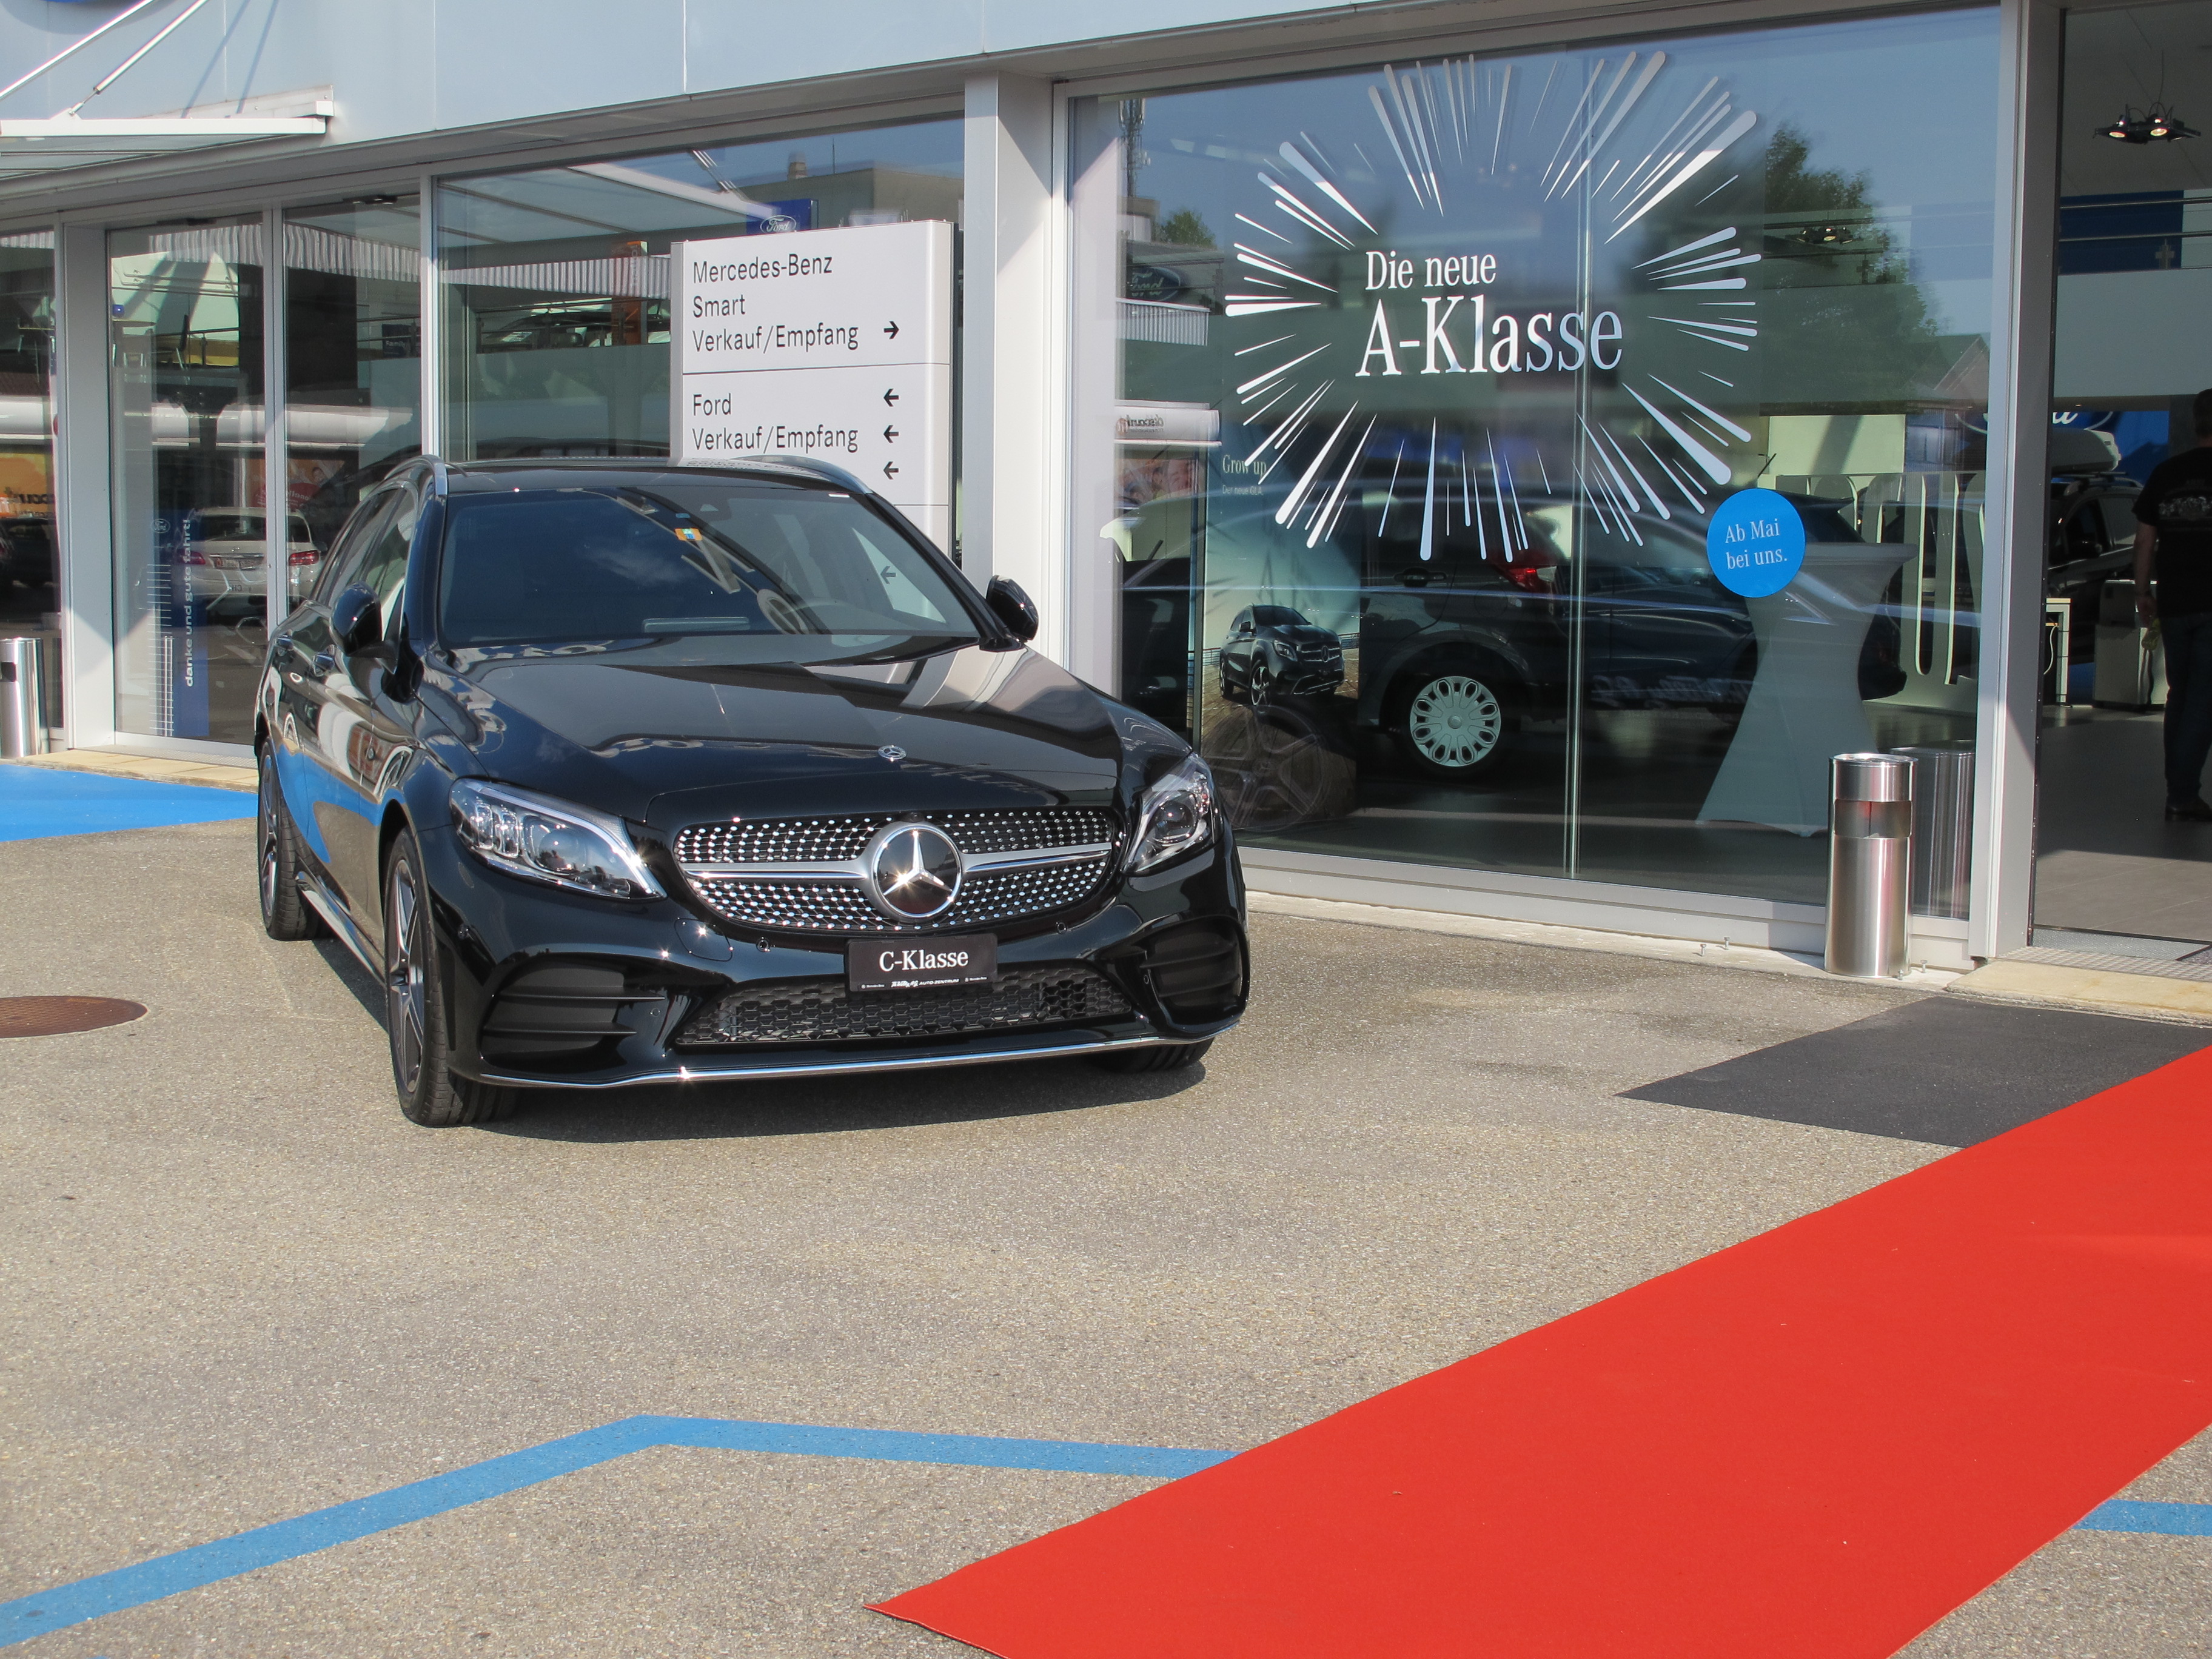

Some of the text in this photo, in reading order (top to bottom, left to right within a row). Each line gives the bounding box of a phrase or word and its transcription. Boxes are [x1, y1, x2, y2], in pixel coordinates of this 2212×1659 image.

[692, 253, 833, 284] Mercedes-Benz
[1365, 250, 1496, 290] Die neue
[692, 294, 746, 318] Smart
[692, 322, 860, 354] Verkauf/Empfang
[1355, 294, 1623, 377] A-Klasse
[692, 392, 732, 417] Ford
[692, 424, 859, 454] Verkauf/Empfang
[1222, 454, 1267, 480] Grow up
[1724, 518, 1780, 544] Ab Mai
[1725, 548, 1788, 570] bei uns.
[183, 519, 194, 688] danke und gute fahrt!
[879, 948, 969, 972] C-Klasse
